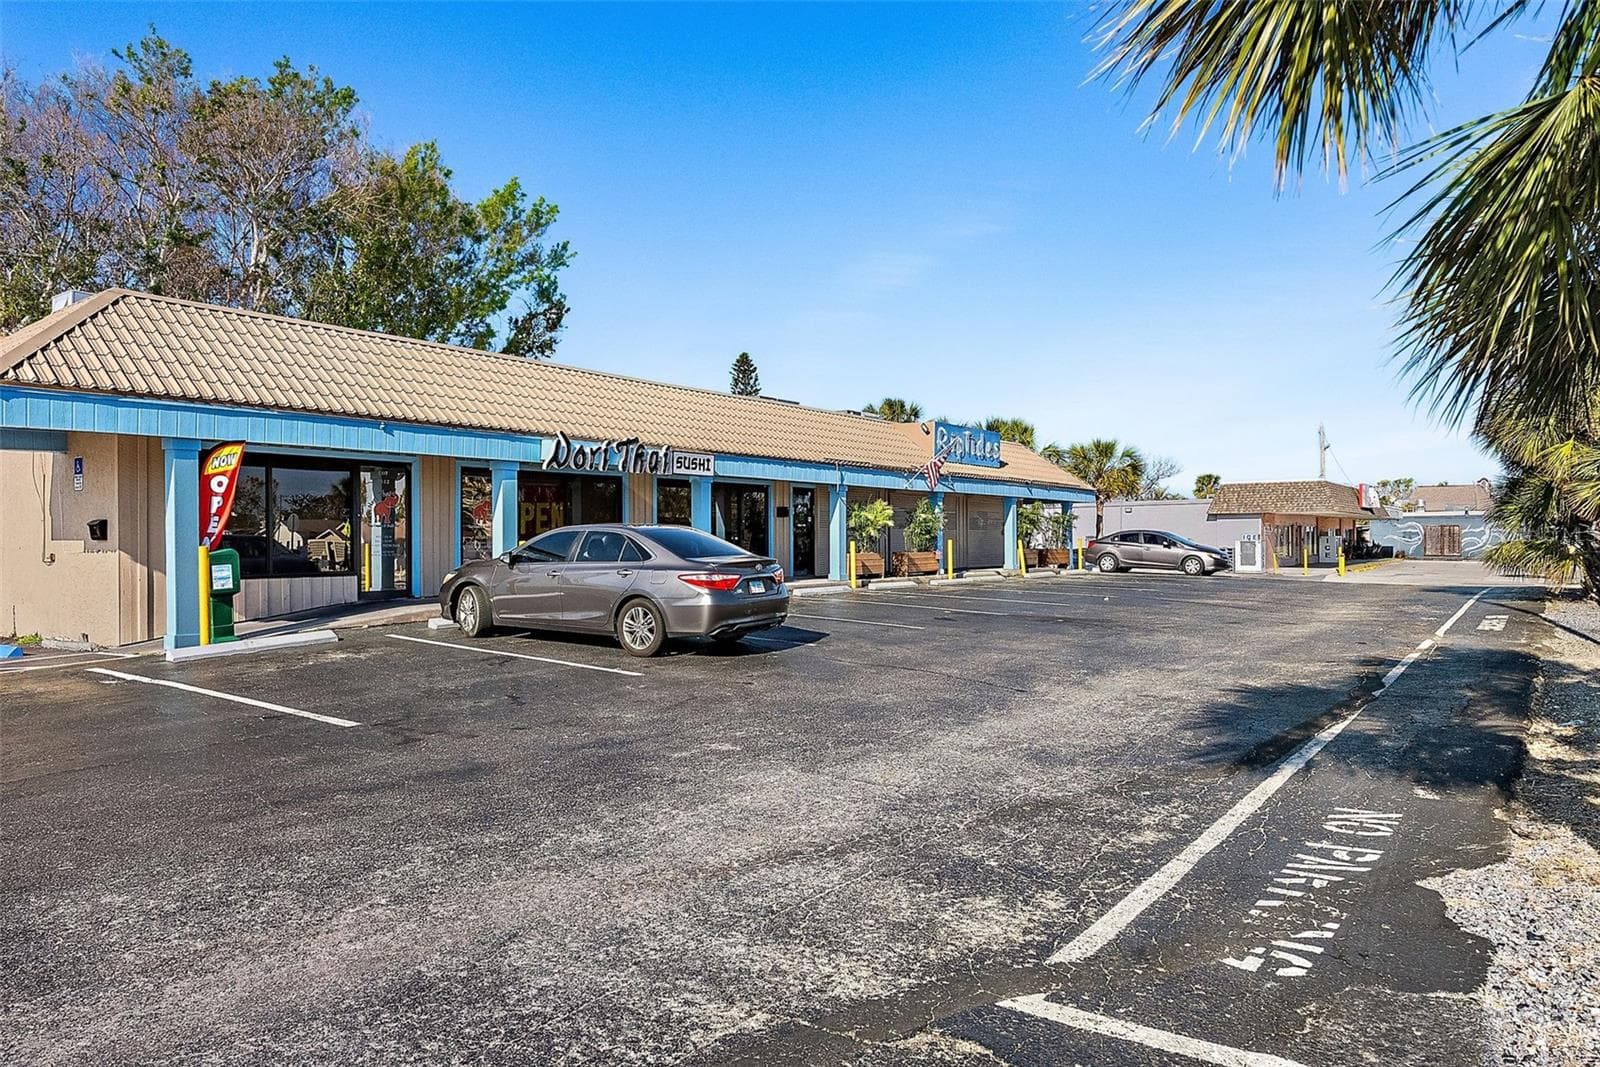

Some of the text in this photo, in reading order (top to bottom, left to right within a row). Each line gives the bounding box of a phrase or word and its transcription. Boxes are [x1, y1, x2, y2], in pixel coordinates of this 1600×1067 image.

[211, 453, 237, 469] NOW
[614, 437, 672, 474] Thai
[676, 456, 712, 472] SUSHI
[520, 502, 564, 534] PEN
[1322, 807, 1403, 836] NO
